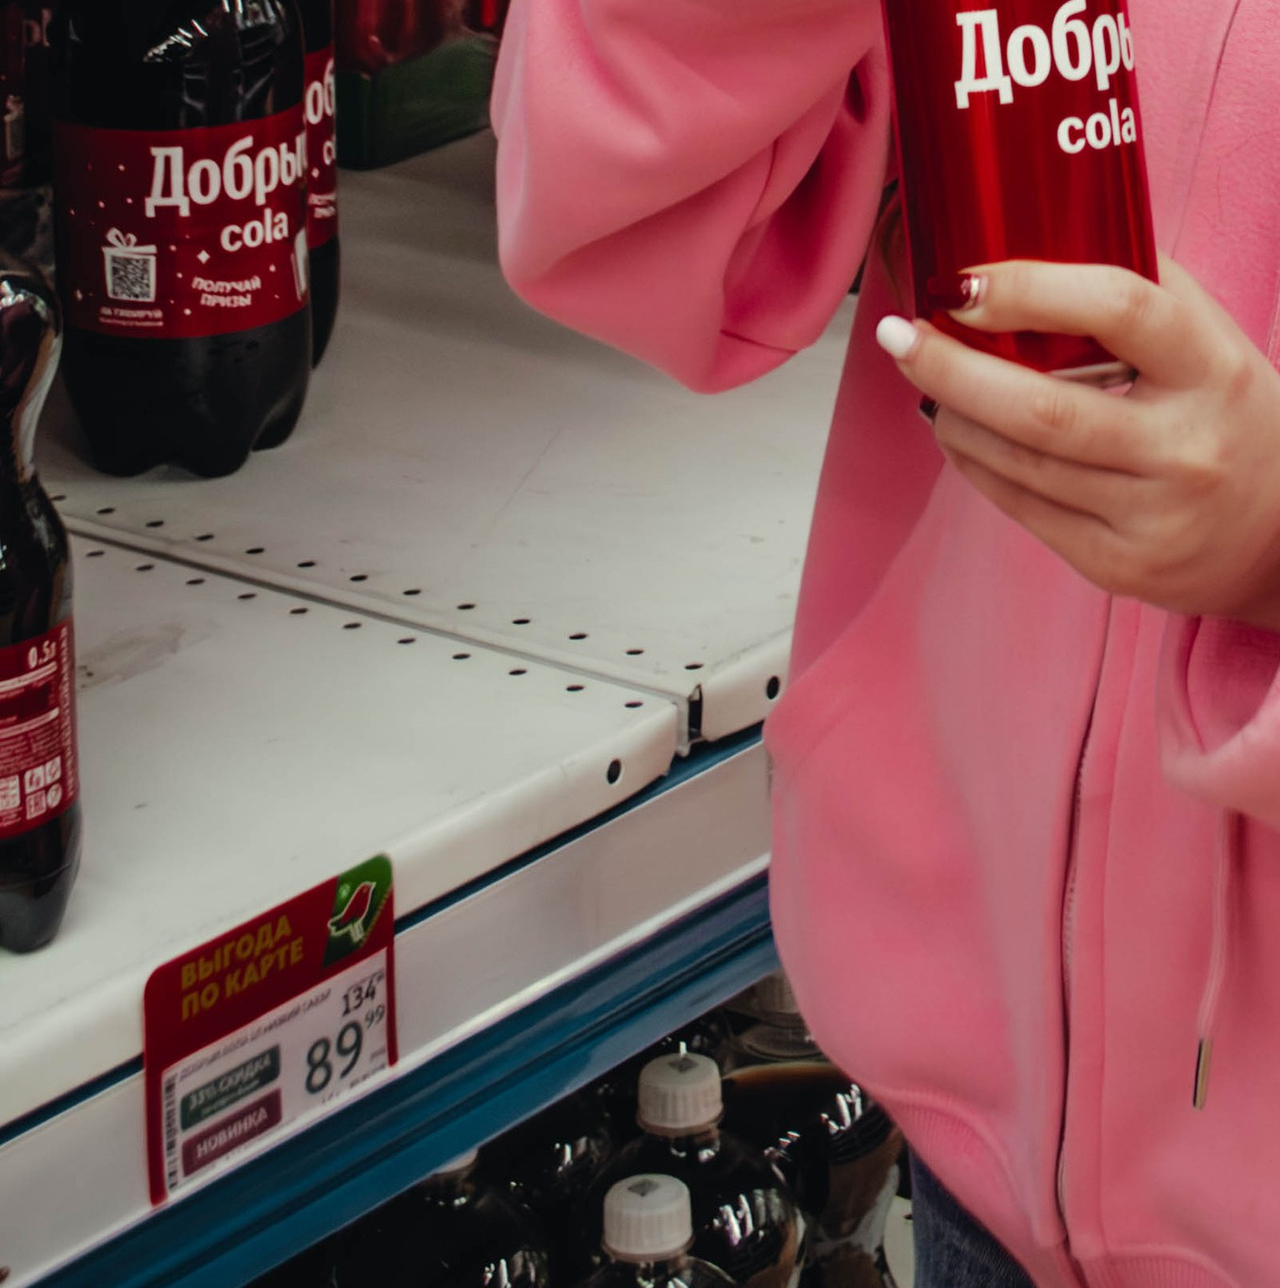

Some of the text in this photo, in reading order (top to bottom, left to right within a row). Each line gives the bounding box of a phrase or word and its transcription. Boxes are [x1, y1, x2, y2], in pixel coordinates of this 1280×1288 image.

[1057, 97, 1137, 155] cola
[145, 135, 307, 218] Добры
[220, 208, 289, 252] cola
[192, 275, 261, 293] ПОЛУЧАЙ
[200, 294, 252, 308] ПРИЗЫ
[181, 914, 292, 991] ВЫГОДА
[182, 936, 304, 1021] ПО КАРТЕ
[341, 979, 376, 1017] 134
[305, 1020, 363, 1094] 89
[196, 1106, 268, 1159] НОВИНКА
